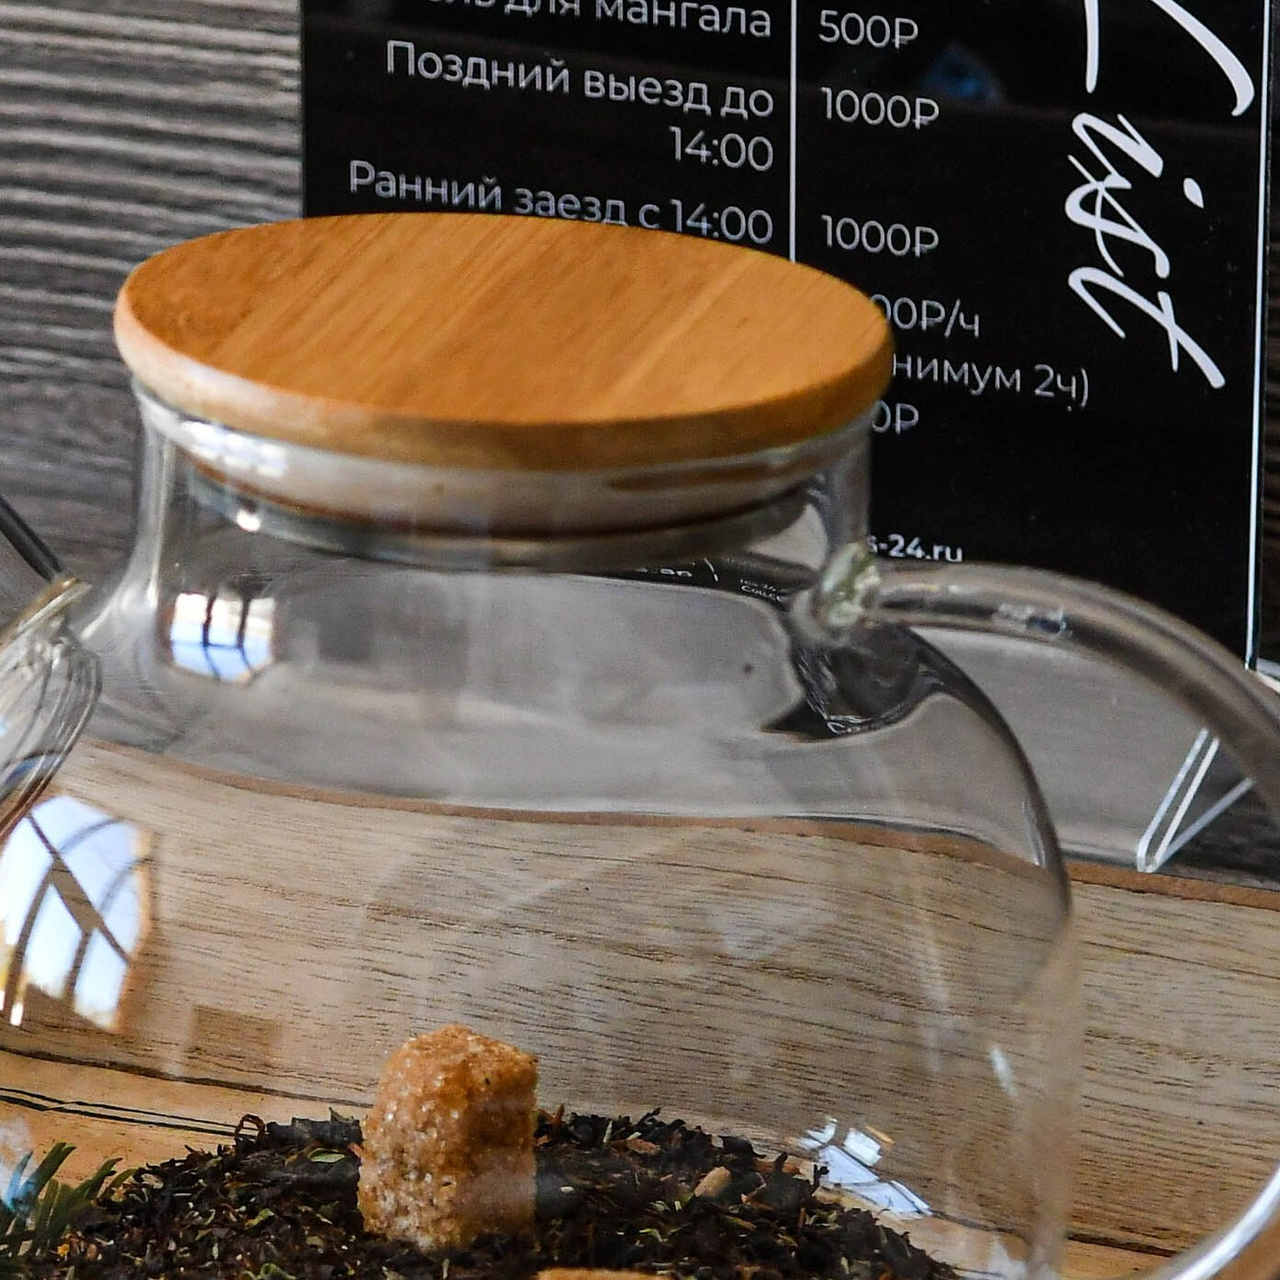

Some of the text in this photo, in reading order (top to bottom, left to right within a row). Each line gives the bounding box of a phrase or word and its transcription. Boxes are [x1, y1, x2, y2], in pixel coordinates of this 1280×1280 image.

[387, 40, 774, 121] Поздний выезд до
[670, 126, 774, 172] 14:00
[350, 160, 774, 243] Ранний заезд с 14:00
[892, 353, 1021, 396] нимум
